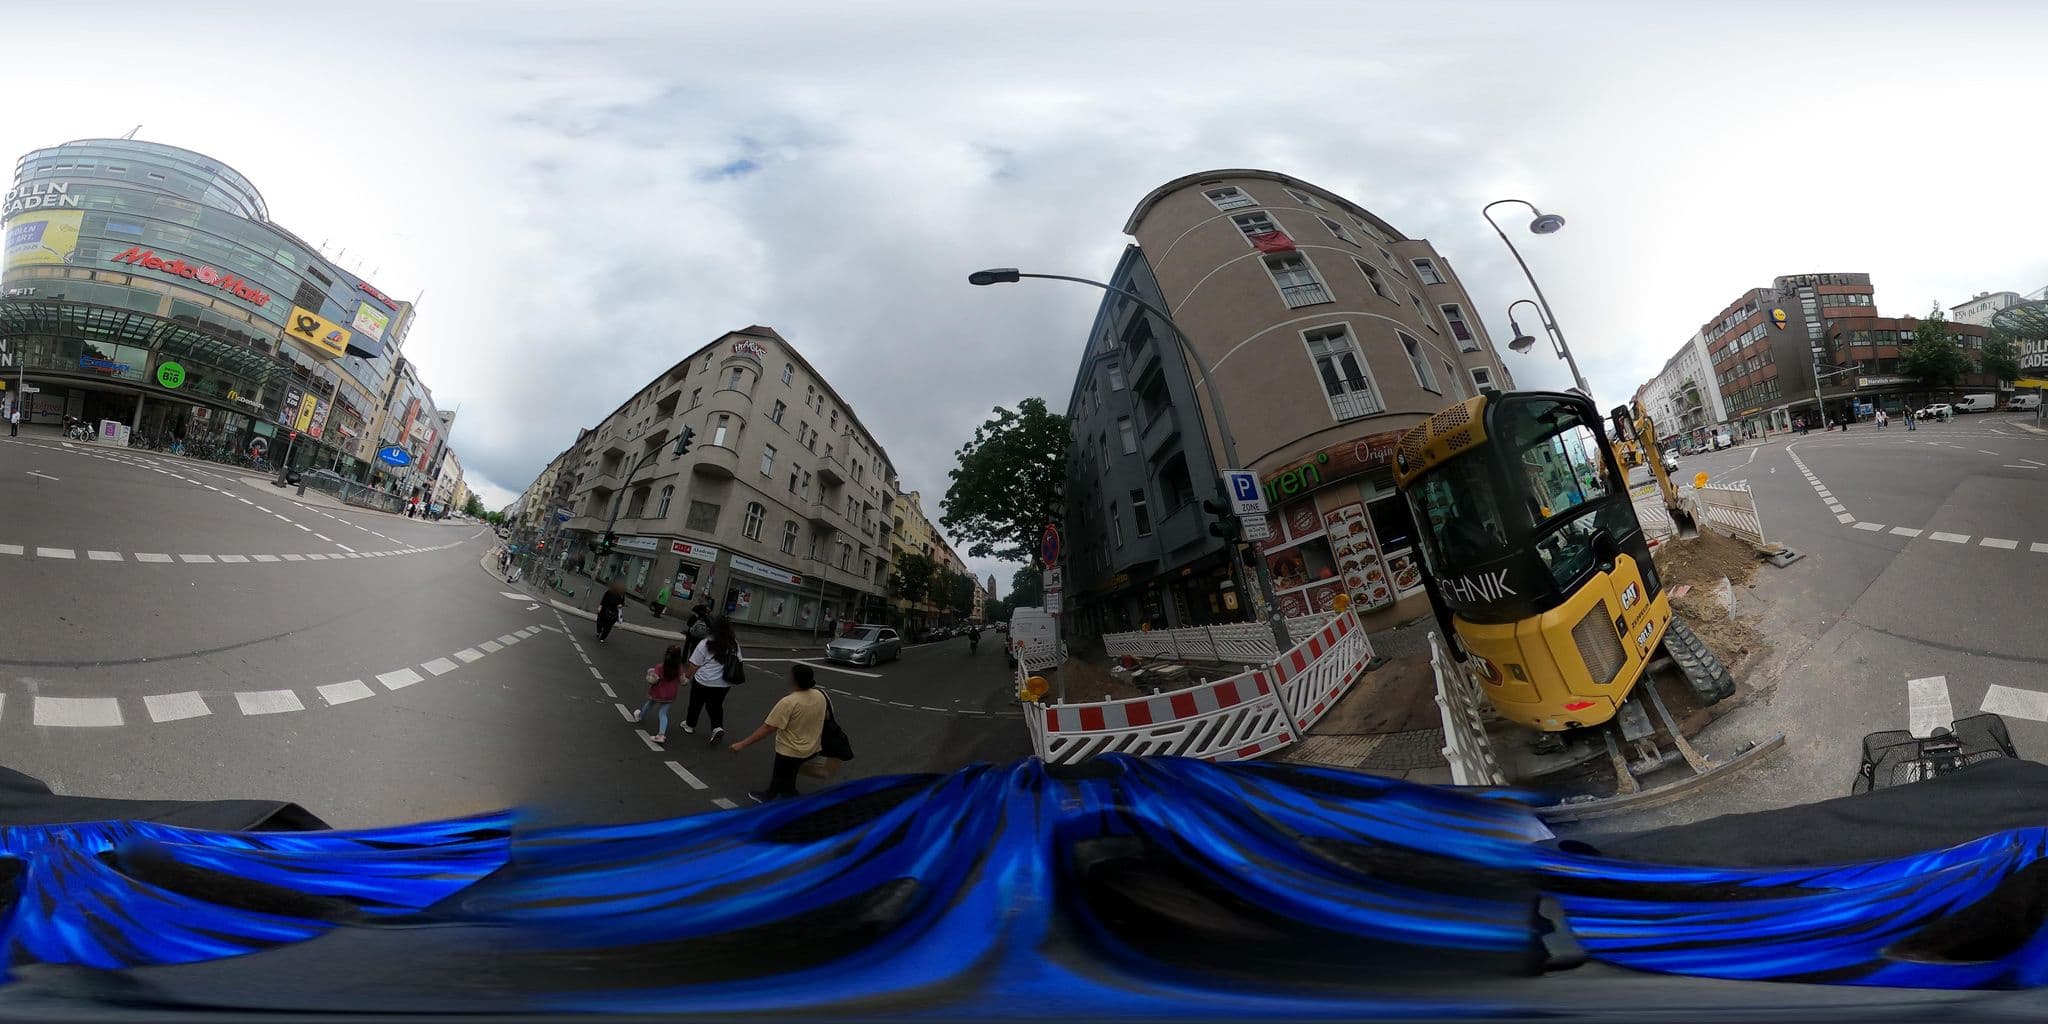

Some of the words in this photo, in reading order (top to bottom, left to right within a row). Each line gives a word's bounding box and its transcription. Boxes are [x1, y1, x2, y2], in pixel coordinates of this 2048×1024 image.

[1237, 477, 1250, 497] P
[1242, 502, 1260, 512] ZONE
[1621, 583, 1638, 611] CAT
